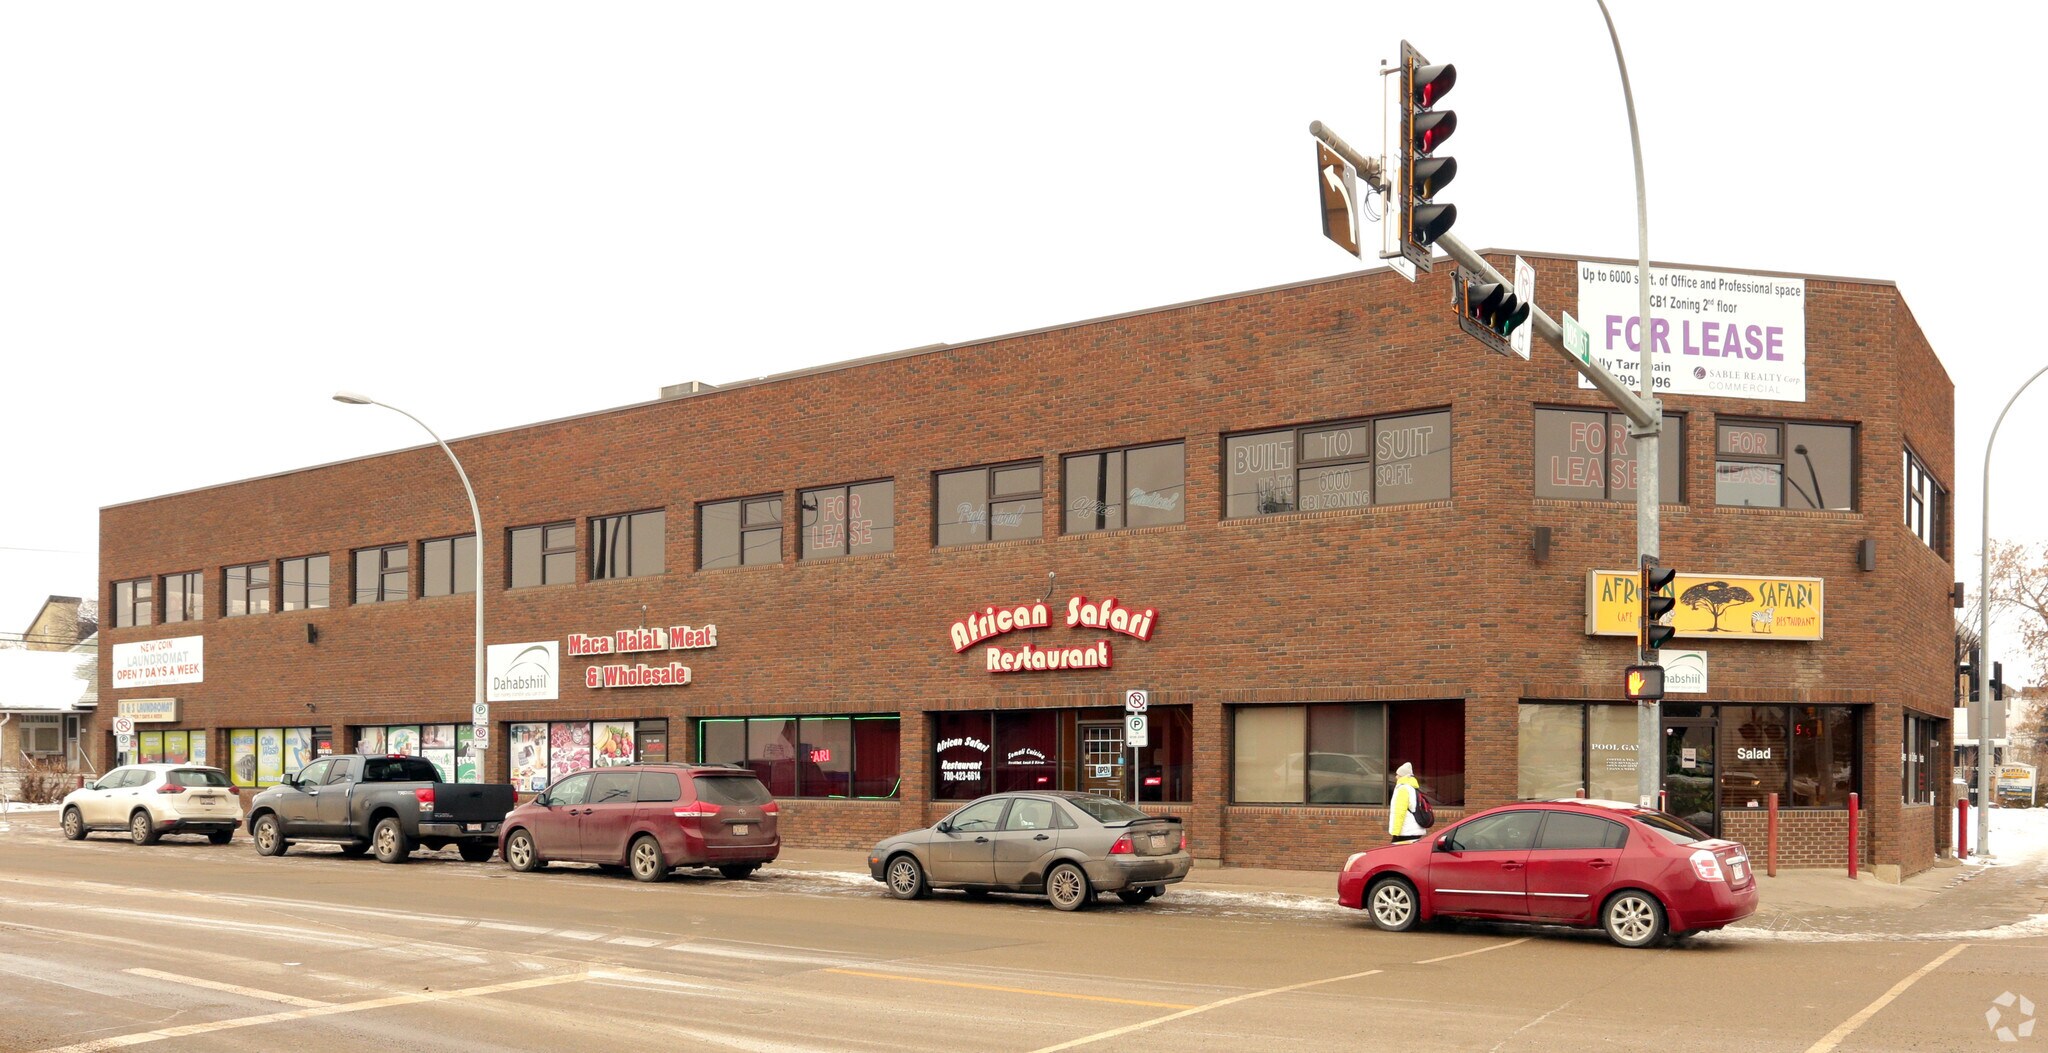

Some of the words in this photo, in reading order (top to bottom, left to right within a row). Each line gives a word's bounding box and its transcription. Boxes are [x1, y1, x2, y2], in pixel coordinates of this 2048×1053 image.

[1582, 267, 1595, 284] Up
[1597, 269, 1607, 282] to
[1609, 269, 1632, 284] 6000
[1659, 274, 1669, 287] of
[1671, 274, 1698, 290] Office
[1700, 278, 1717, 291] and
[1719, 278, 1773, 296] Professional
[1775, 285, 1801, 298] space
[1649, 294, 1667, 308] CB1
[1670, 296, 1700, 314] Zoning
[1717, 299, 1738, 313] floor
[1605, 314, 1672, 354] FOR
[1682, 319, 1785, 362] LEASE
[1708, 381, 1781, 394] COMMERCIAL
[1709, 369, 1741, 380] SABLE
[1744, 371, 1782, 382] REALTY
[1784, 375, 1801, 385] Corp
[1234, 441, 1294, 475] BUILT
[1320, 430, 1353, 459] TO
[1376, 426, 1433, 461] SUIT
[1570, 422, 1628, 456] FOR
[1728, 431, 1768, 455] FOR
[1276, 474, 1295, 497] TO
[1319, 468, 1352, 493] 6000
[1551, 456, 1638, 490] LEASE
[1716, 462, 1778, 486] LEASE
[823, 494, 862, 522] FOR
[1323, 490, 1370, 510] ZONING
[812, 520, 873, 550] LEASE
[1602, 576, 1675, 604] AFRN
[950, 601, 1049, 651] African
[1066, 596, 1154, 639] Safari
[140, 643, 155, 653] NEW
[158, 640, 173, 651] COIN
[568, 635, 609, 655] Maca
[670, 626, 712, 649] Meat
[127, 650, 189, 668] LAUNDROMAT
[986, 641, 1109, 672] Restaurant
[117, 668, 137, 680] OPEN
[138, 668, 143, 678] 7
[145, 665, 167, 678] DAYS
[169, 665, 175, 676] A
[177, 663, 200, 675] WEEK
[493, 674, 547, 690] Dahabshiil
[587, 667, 598, 687] &
[604, 663, 686, 687] Wholesale
[936, 737, 963, 753] African
[964, 736, 990, 753] Safari
[1591, 743, 1619, 751] POOL
[1737, 747, 1771, 760] Salad
[941, 760, 983, 770] Restaurant
[1097, 765, 1110, 774] OPEN
